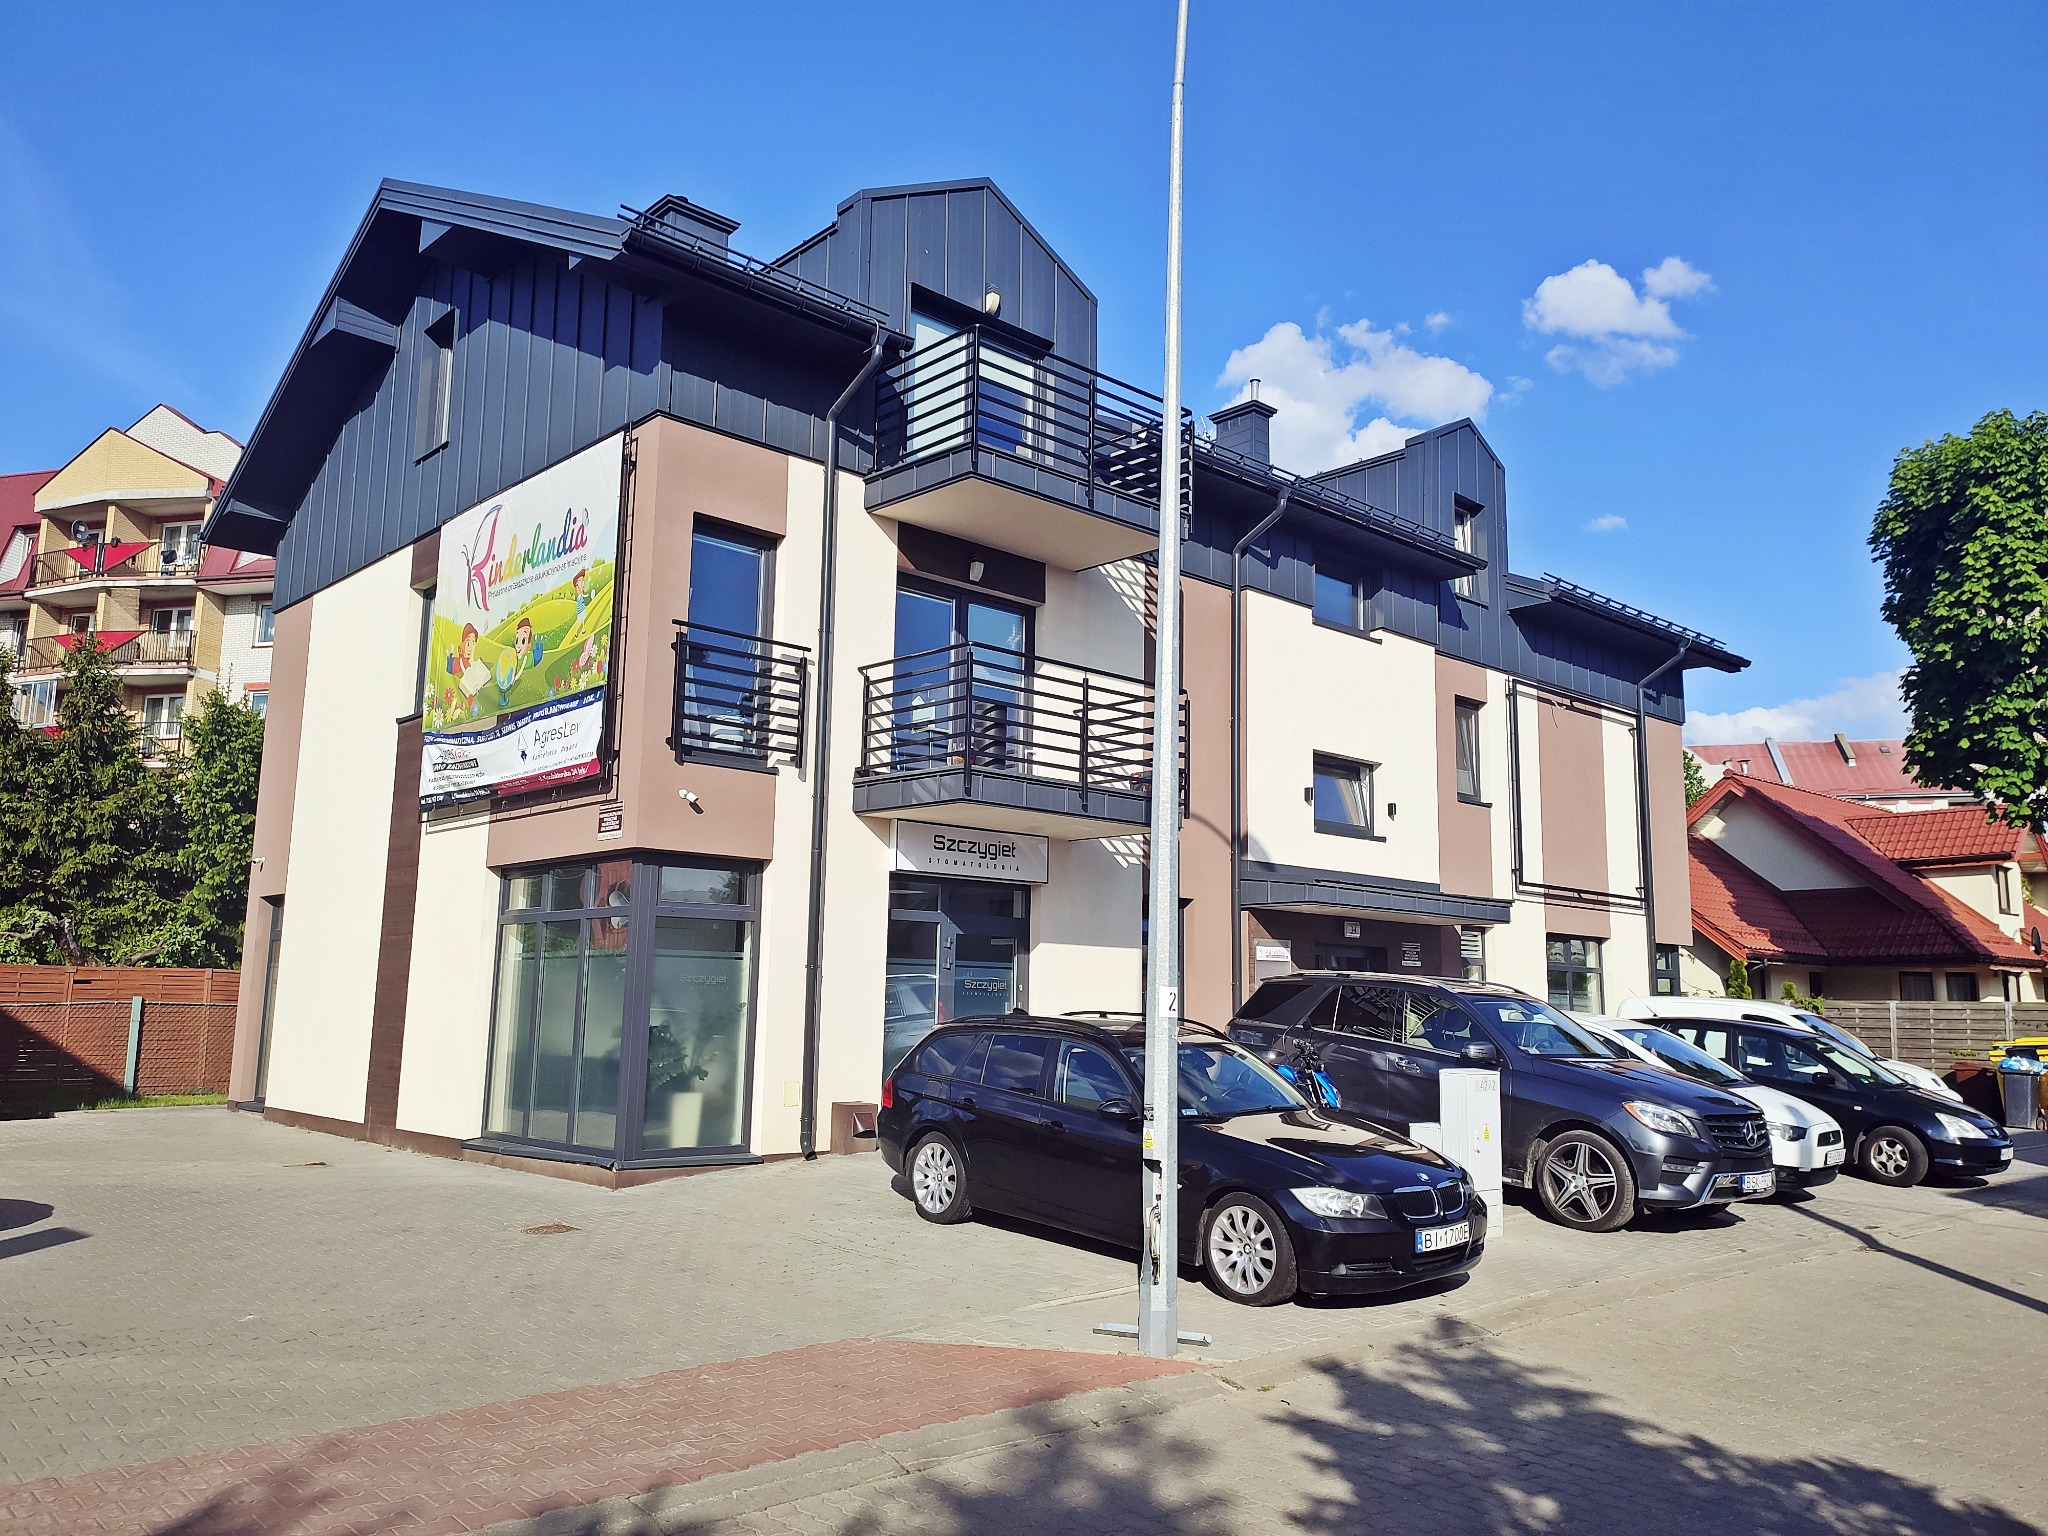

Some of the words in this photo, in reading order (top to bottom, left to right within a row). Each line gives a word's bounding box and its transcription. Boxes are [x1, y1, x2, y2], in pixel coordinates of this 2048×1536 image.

[461, 504, 588, 611] Kinderlandia
[928, 857, 1020, 872] STOMATOLOGIA
[1169, 992, 1177, 1011] 2
[1424, 1231, 1438, 1249] BI
